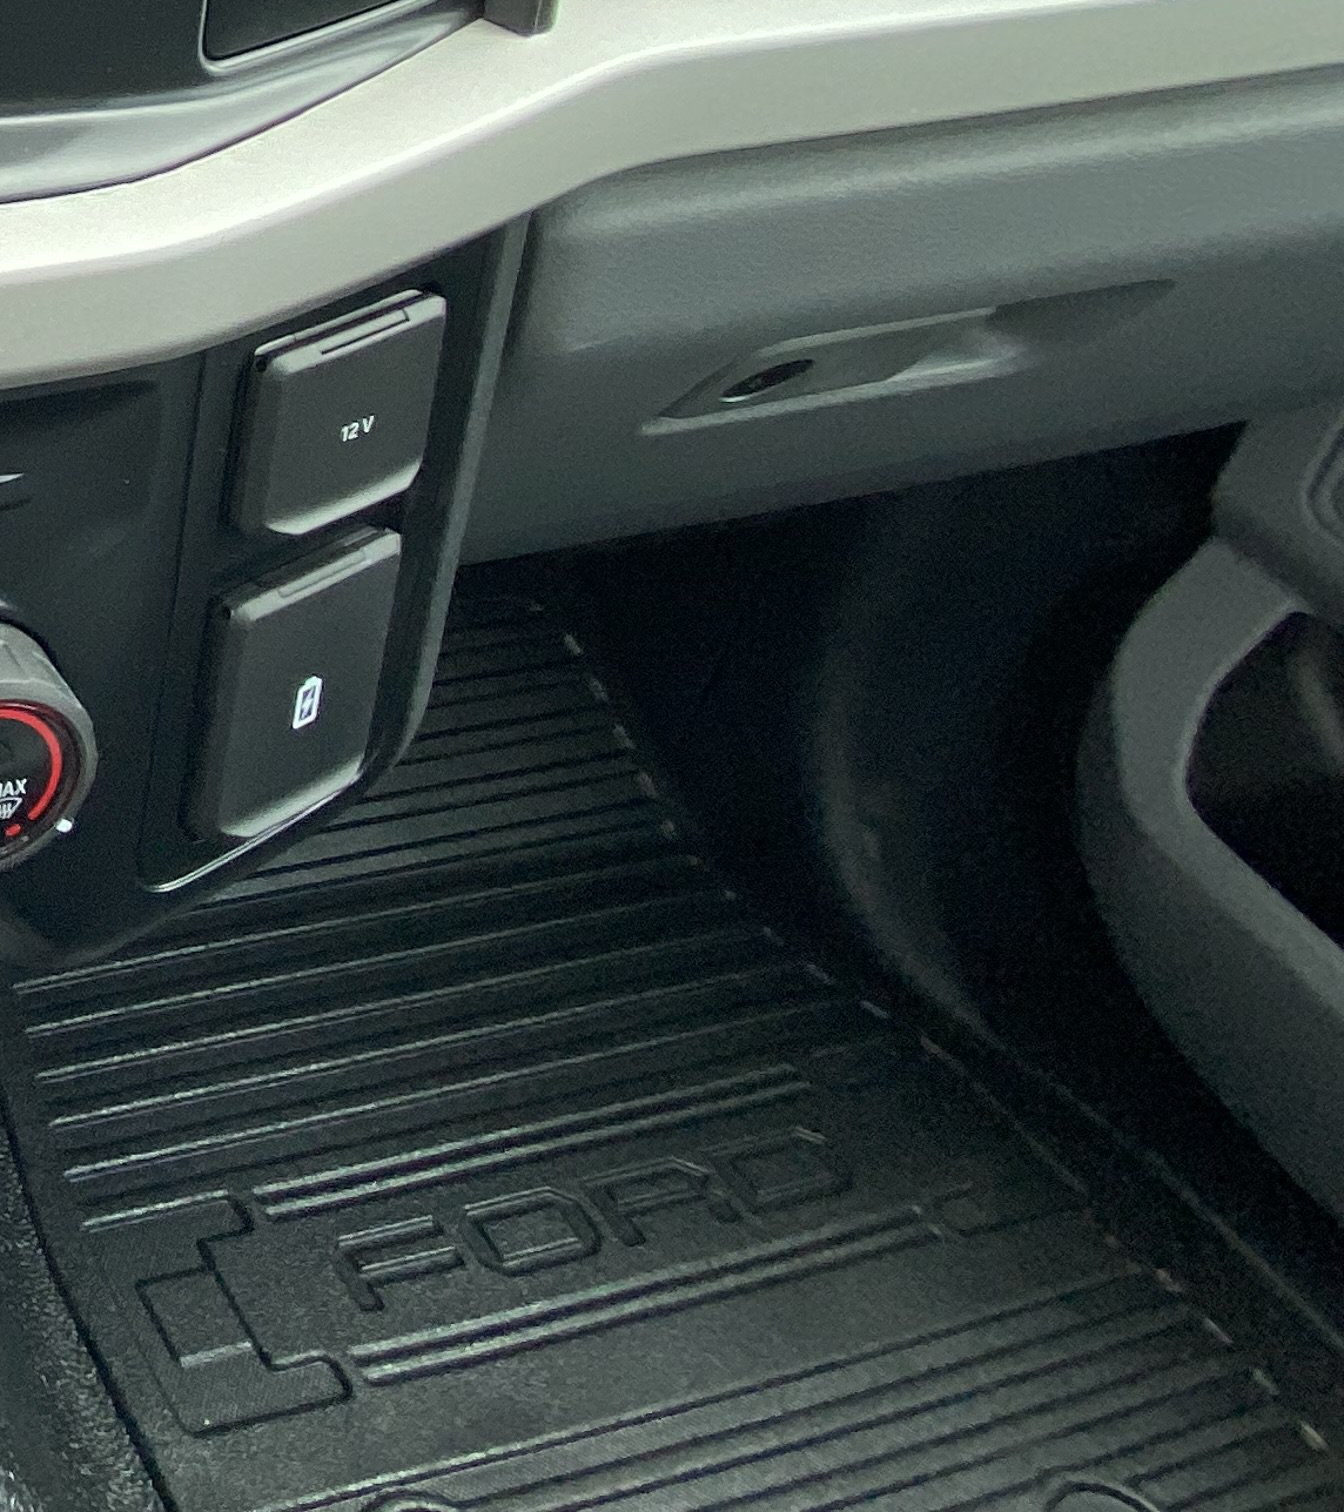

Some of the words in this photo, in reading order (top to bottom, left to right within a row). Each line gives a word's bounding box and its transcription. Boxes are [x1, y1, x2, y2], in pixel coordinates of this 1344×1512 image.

[340, 421, 360, 442] 12
[361, 415, 375, 434] V
[334, 1126, 852, 1312] FORD
